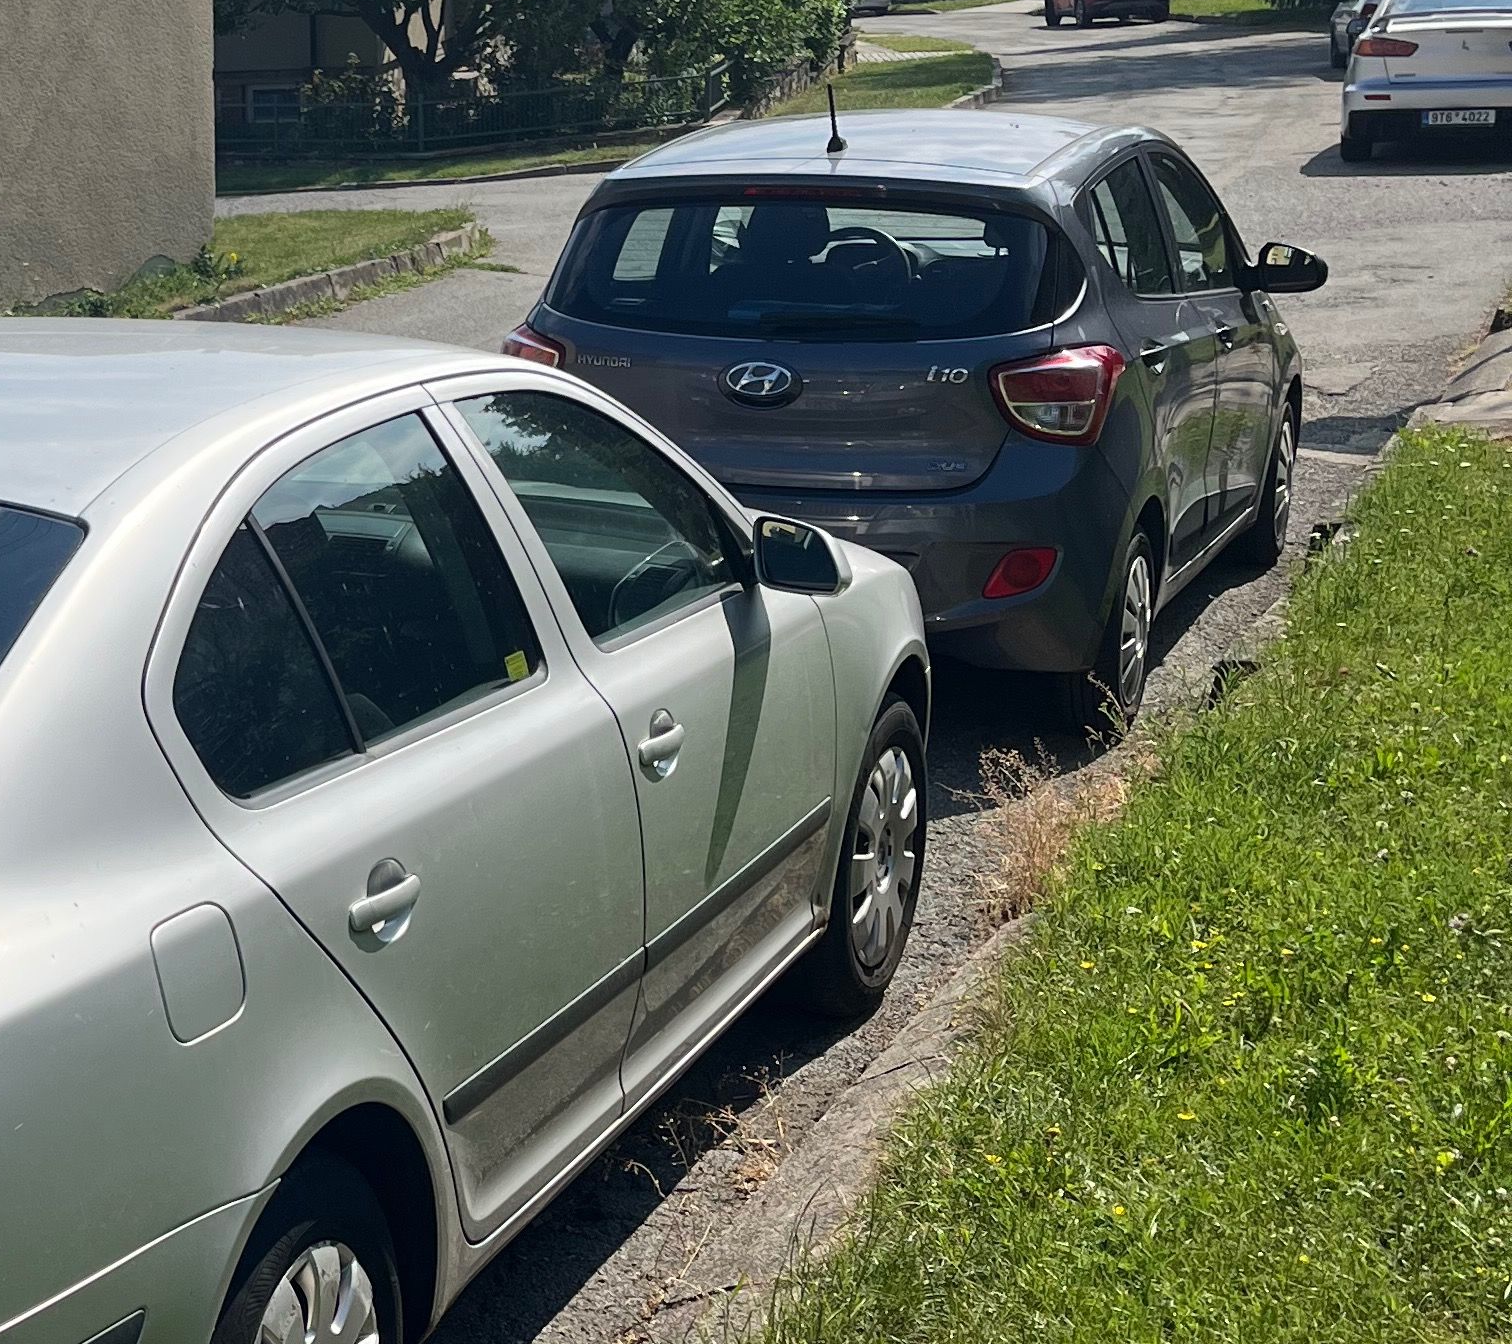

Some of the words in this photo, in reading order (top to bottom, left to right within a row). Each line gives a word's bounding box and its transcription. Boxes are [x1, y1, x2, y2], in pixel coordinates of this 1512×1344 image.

[1462, 111, 1489, 122] 4022
[578, 355, 631, 368] HYUNDAI
[927, 365, 968, 384] i10
